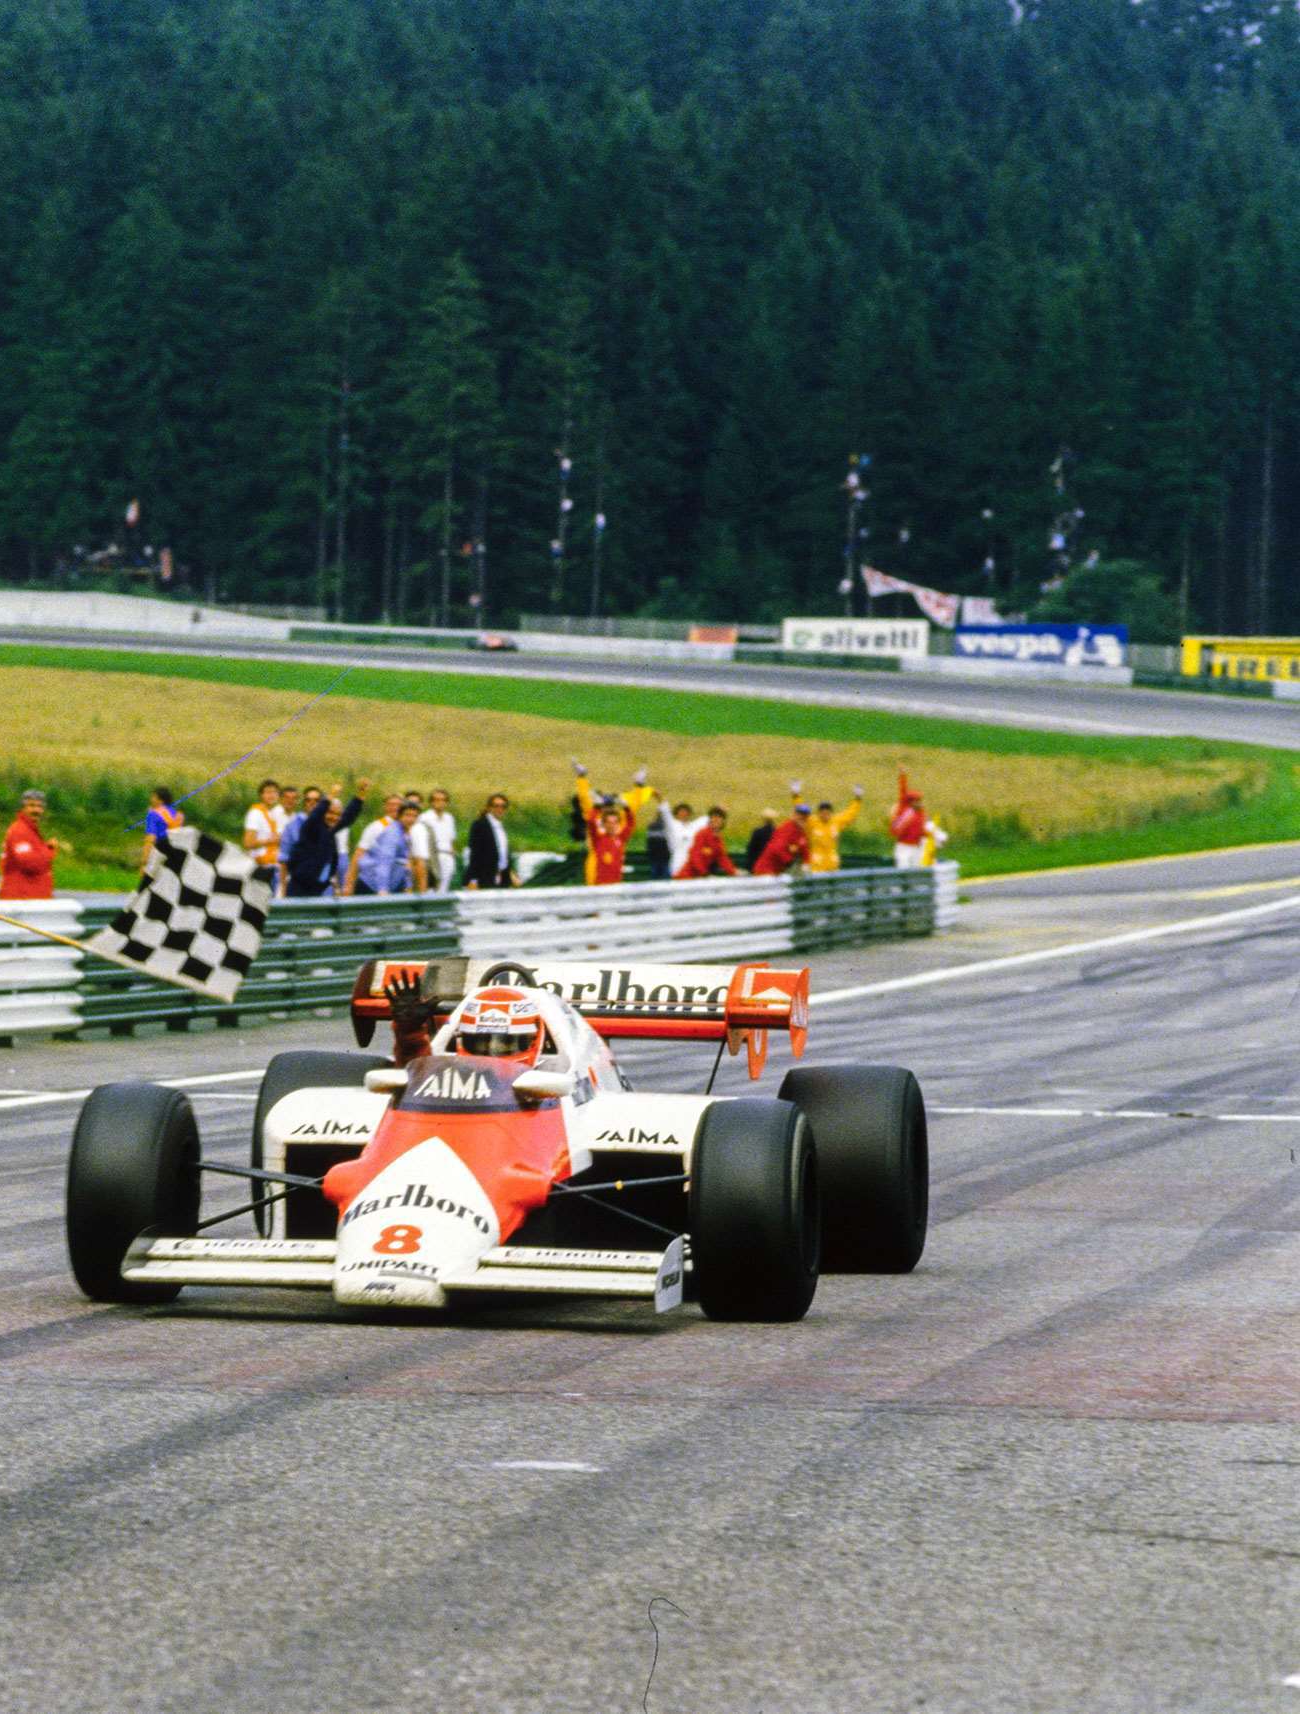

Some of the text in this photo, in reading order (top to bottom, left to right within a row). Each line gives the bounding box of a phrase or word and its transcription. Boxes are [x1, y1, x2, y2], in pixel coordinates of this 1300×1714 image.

[957, 633, 1062, 659] vespa
[343, 1184, 490, 1234] Marlboro
[372, 1224, 423, 1254] 8
[341, 1259, 439, 1275] UNIPART
